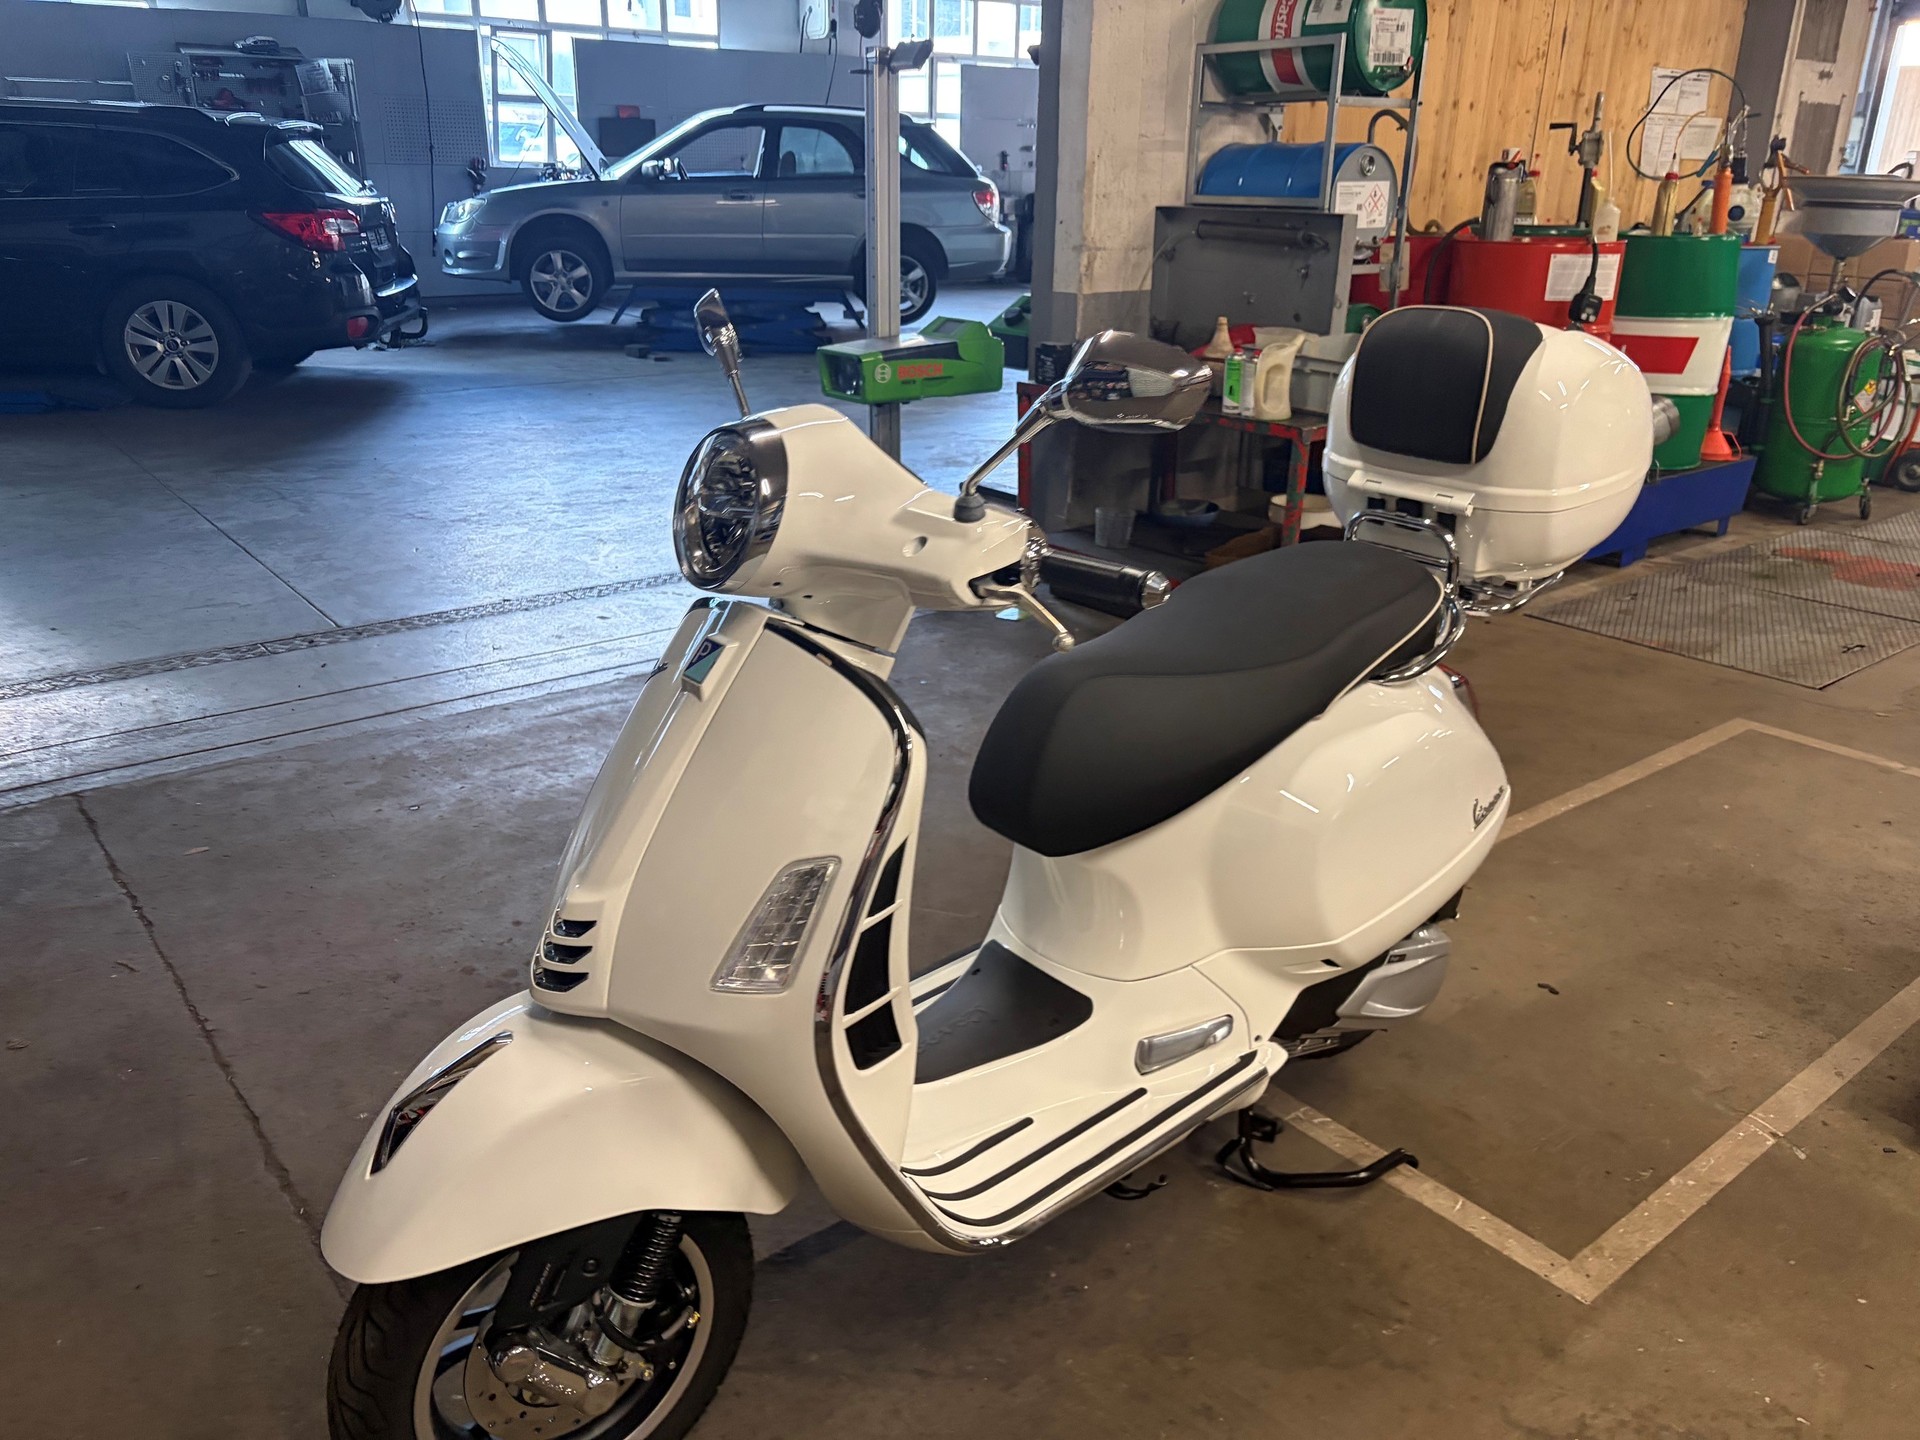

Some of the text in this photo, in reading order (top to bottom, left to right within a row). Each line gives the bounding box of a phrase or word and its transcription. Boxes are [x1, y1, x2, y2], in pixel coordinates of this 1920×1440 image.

[1275, 0, 1294, 40] astr
[898, 363, 943, 380] BOSCH
[692, 641, 712, 663] P
